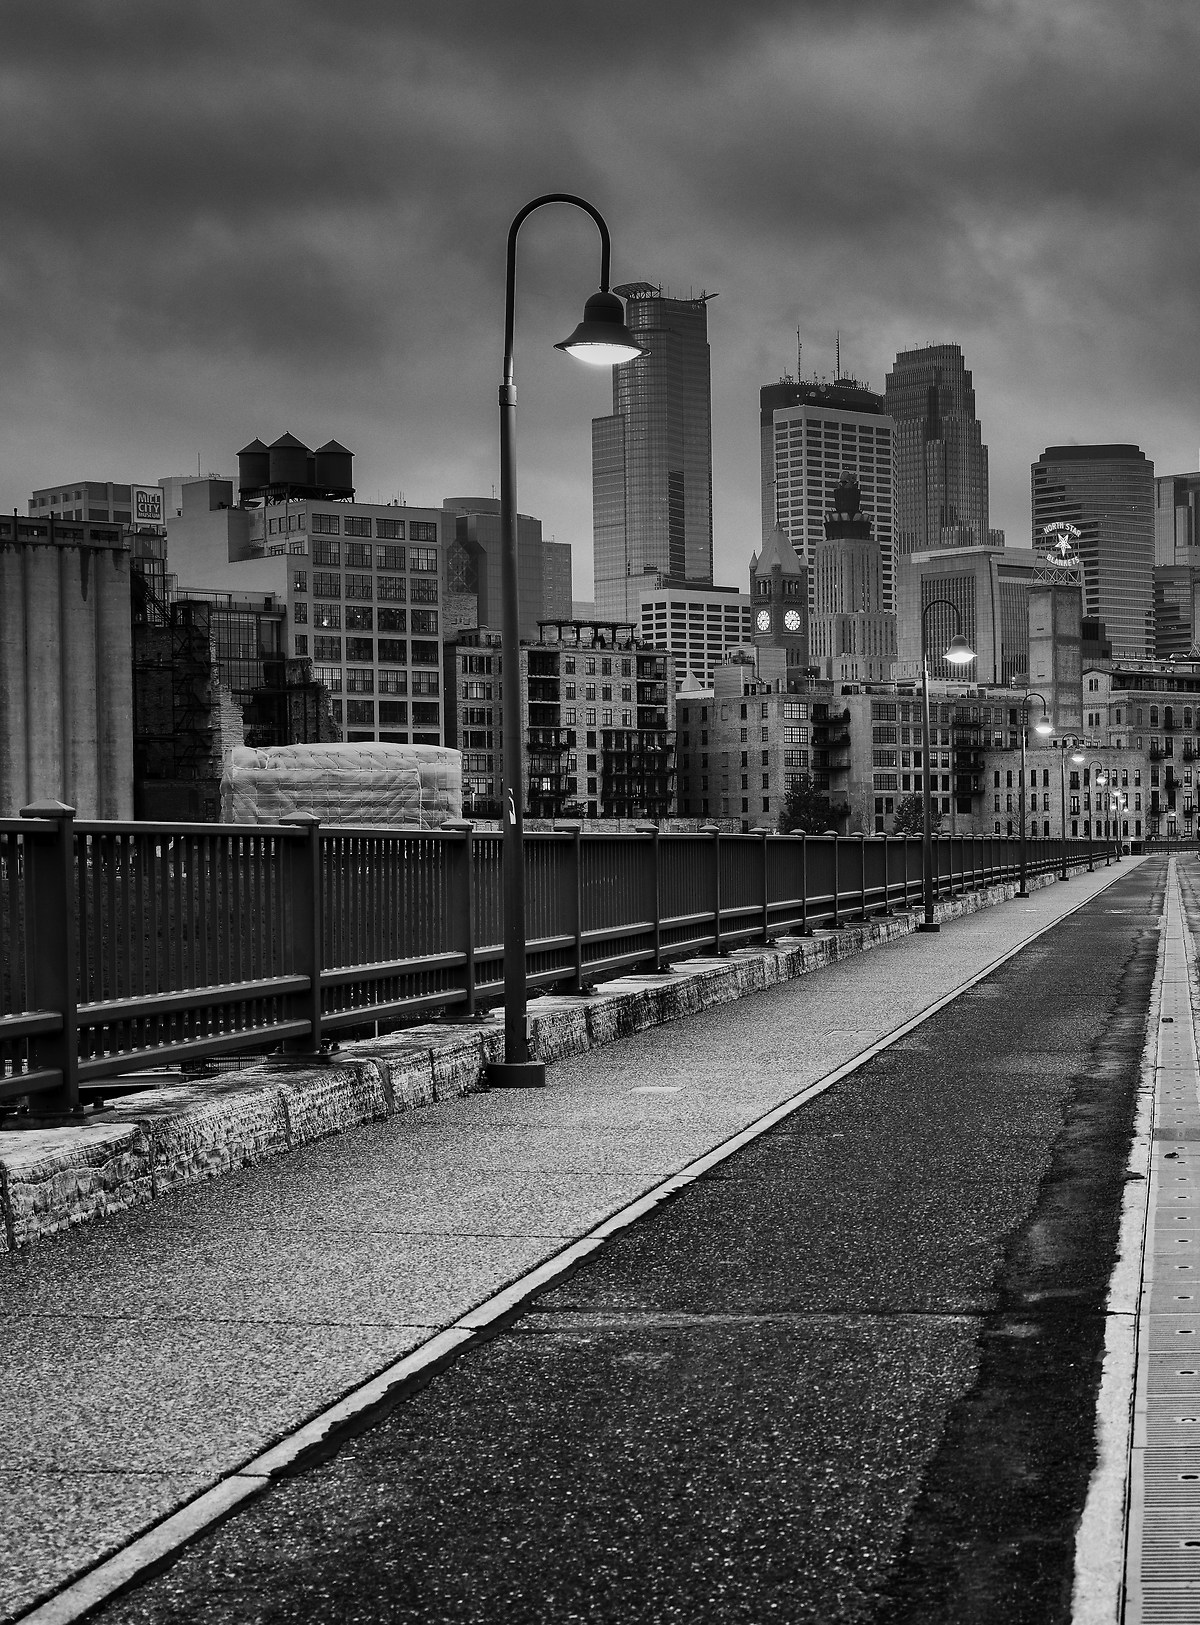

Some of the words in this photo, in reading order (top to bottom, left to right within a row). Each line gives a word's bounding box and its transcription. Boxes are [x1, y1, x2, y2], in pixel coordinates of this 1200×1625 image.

[138, 493, 160, 504] MILL
[138, 503, 160, 513] CITY
[1043, 521, 1064, 534] NORTH
[1065, 523, 1082, 537] STAR
[1046, 553, 1080, 567] BLANKETS
